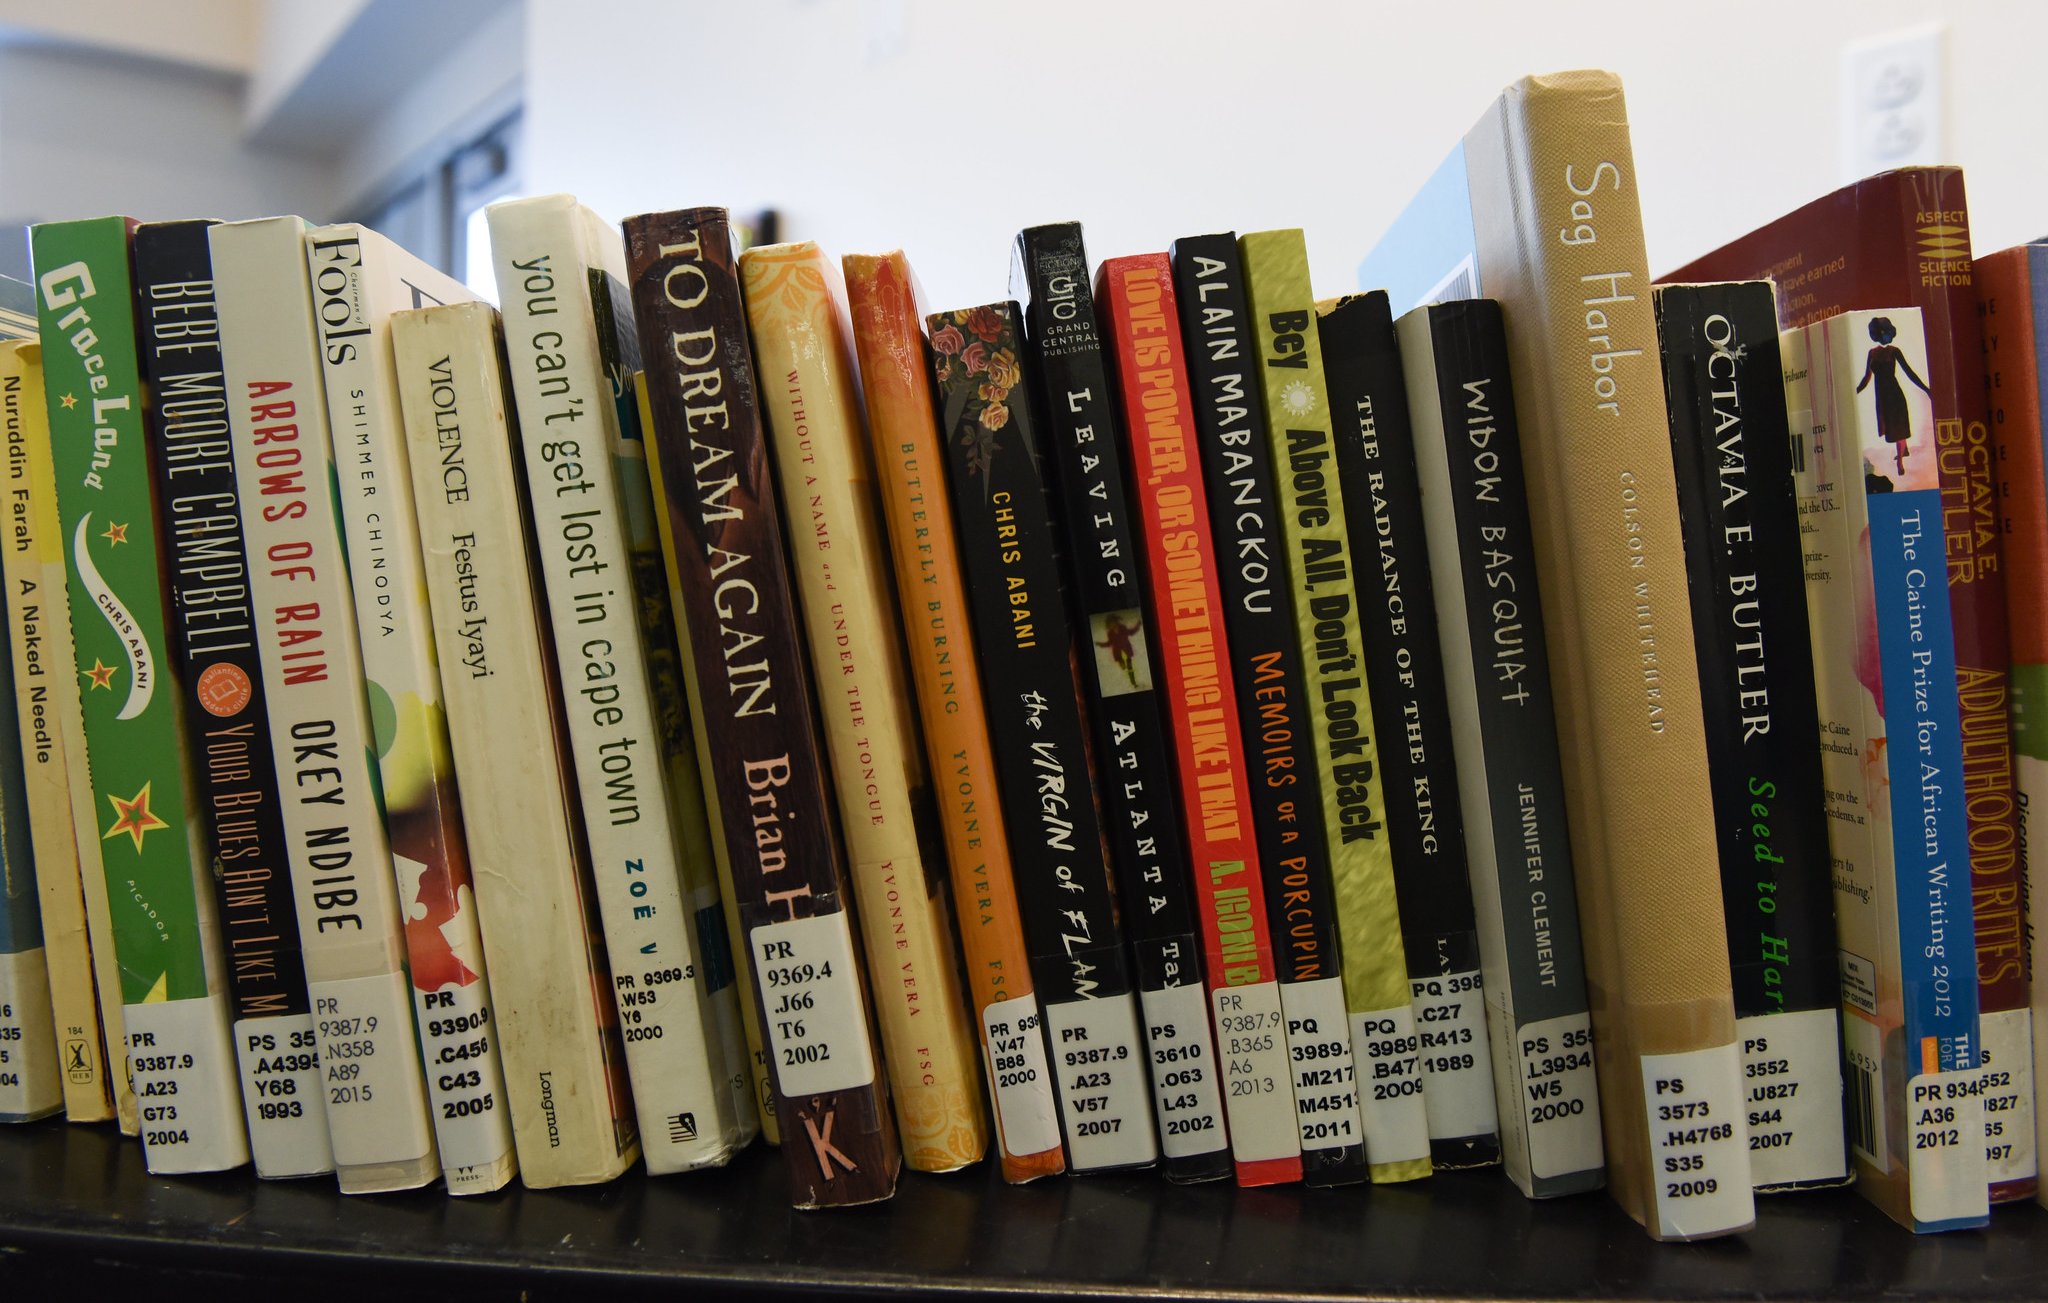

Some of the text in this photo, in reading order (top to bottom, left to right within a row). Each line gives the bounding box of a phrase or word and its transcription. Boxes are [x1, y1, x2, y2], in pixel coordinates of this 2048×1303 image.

[1916, 211, 1965, 224] ASPECT
[1807, 255, 1845, 282] earned
[1919, 261, 1971, 273] SCIENCE
[1560, 161, 1642, 417] Sag Harbor
[1922, 275, 1971, 287] FICTION
[350, 272, 361, 314] Chairman
[1047, 321, 1090, 335] GRAND
[1042, 333, 1099, 348] CENTRAL
[1044, 343, 1100, 357] PUBLISHING
[427, 354, 470, 505] VIOLENCE
[1193, 256, 1272, 614] ALAIN MABANCKOU
[1463, 378, 1502, 503] WIDOW
[4, 376, 32, 553] Nuruddin Farah
[150, 280, 252, 660] BEBE MOORE CAMPBELL
[658, 229, 777, 718] TO DREAM AGAIN
[1809, 498, 1840, 513] the US...
[1935, 417, 1974, 587] BUTLER
[350, 389, 395, 638] SHIMMER CHINODYA
[247, 381, 328, 686] ARROWS OF RAIN
[512, 254, 640, 826] you can't get lost cape town
[1703, 313, 1772, 747] OCTAVIA BUTLER
[1123, 268, 1242, 843] LOVE SOMETHING LIKE THAT
[1805, 550, 1823, 566] prize
[452, 531, 481, 612] Festus
[902, 443, 958, 715] BUTTERFLY BURNING
[992, 491, 1036, 649] CHRIS ABANI
[786, 370, 884, 826] WITHOUT NAME and UNDER THE TONGUE
[1619, 470, 1665, 734] COLSON WHITEHEAD
[1357, 395, 1438, 856] THE RADIANCE OF THE KING
[98, 594, 147, 689] CHRIS ABANI
[1286, 429, 1382, 846] Above Look Back
[1067, 387, 1167, 915] LEAVING ATLANTA
[23, 606, 51, 764] Naked Needle
[1828, 721, 1850, 736] Caine
[1251, 651, 1299, 844] MEMOIRS A
[1020, 690, 1076, 852] the VIRGIN
[1901, 509, 1951, 1018] The Caine Prize African Writing 2012
[1847, 791, 1858, 804] the
[743, 752, 796, 875] Brian
[1749, 776, 1784, 864] Seed
[290, 719, 363, 934] OKEY NDIBE
[1955, 665, 2021, 986] ADULTHOOD RITES
[953, 750, 993, 926] YVONNE VERA
[204, 723, 280, 984] YOUR BLUES LIKE
[1518, 783, 1557, 988] JENNIFER CLEMENT
[128, 879, 169, 942] PICADOR
[1213, 886, 1258, 965] IGONI
[881, 860, 920, 1017] YVONNE VERA
[644, 966, 695, 986] 9369.3
[767, 960, 833, 988] 9369.4
[621, 992, 657, 1007] .W53
[622, 1011, 641, 1025] Y6
[1222, 1011, 1280, 1033] 9387.9
[1417, 1004, 1462, 1023] .C27
[67, 1027, 83, 1035] 184
[319, 1016, 378, 1038] 9387.9
[625, 1025, 664, 1042] 2000
[778, 1022, 806, 1040] T6
[1226, 1035, 1274, 1055] .B365
[1421, 1028, 1473, 1048] R413
[324, 1039, 375, 1060] .N358
[783, 1043, 831, 1066] 2002
[1065, 1045, 1128, 1066] 9387.9
[1154, 1044, 1201, 1064] 3610
[1955, 1032, 1970, 1069] THE
[135, 1054, 193, 1072] 9387.9
[327, 1063, 361, 1082] A89
[917, 1047, 934, 1087] FSG
[996, 1054, 1025, 1071] B88
[1229, 1059, 1253, 1076] A6
[1424, 1054, 1474, 1073] 1989
[1745, 1059, 1789, 1078] 3552
[140, 1081, 178, 1097] .A23
[255, 1079, 297, 1097] Y68
[439, 1070, 481, 1092] C43
[999, 1069, 1036, 1088] 2000
[1070, 1072, 1111, 1090] .A23
[1231, 1077, 1275, 1097] 2013
[330, 1085, 373, 1104] 2015
[1529, 1080, 1563, 1100] W5
[258, 1101, 303, 1120] 1993
[442, 1093, 493, 1119] 2005
[539, 1070, 560, 1150] Longman
[1073, 1096, 1109, 1113] V57
[1163, 1093, 1198, 1111] L43
[1531, 1099, 1584, 1124] 2000
[1659, 1101, 1710, 1120] 3573
[143, 1105, 177, 1121] G73
[1749, 1108, 1782, 1127] S44
[1916, 1107, 1954, 1126] .A36
[1077, 1119, 1122, 1137] 2007
[1167, 1115, 1214, 1135] 2002
[1662, 1123, 1733, 1148] .H4768
[147, 1130, 189, 1145] 2004
[1750, 1131, 1793, 1150] 2007
[1916, 1129, 1959, 1149] 2012
[1664, 1155, 1704, 1173] S35
[1666, 1179, 1717, 1198] 2009
